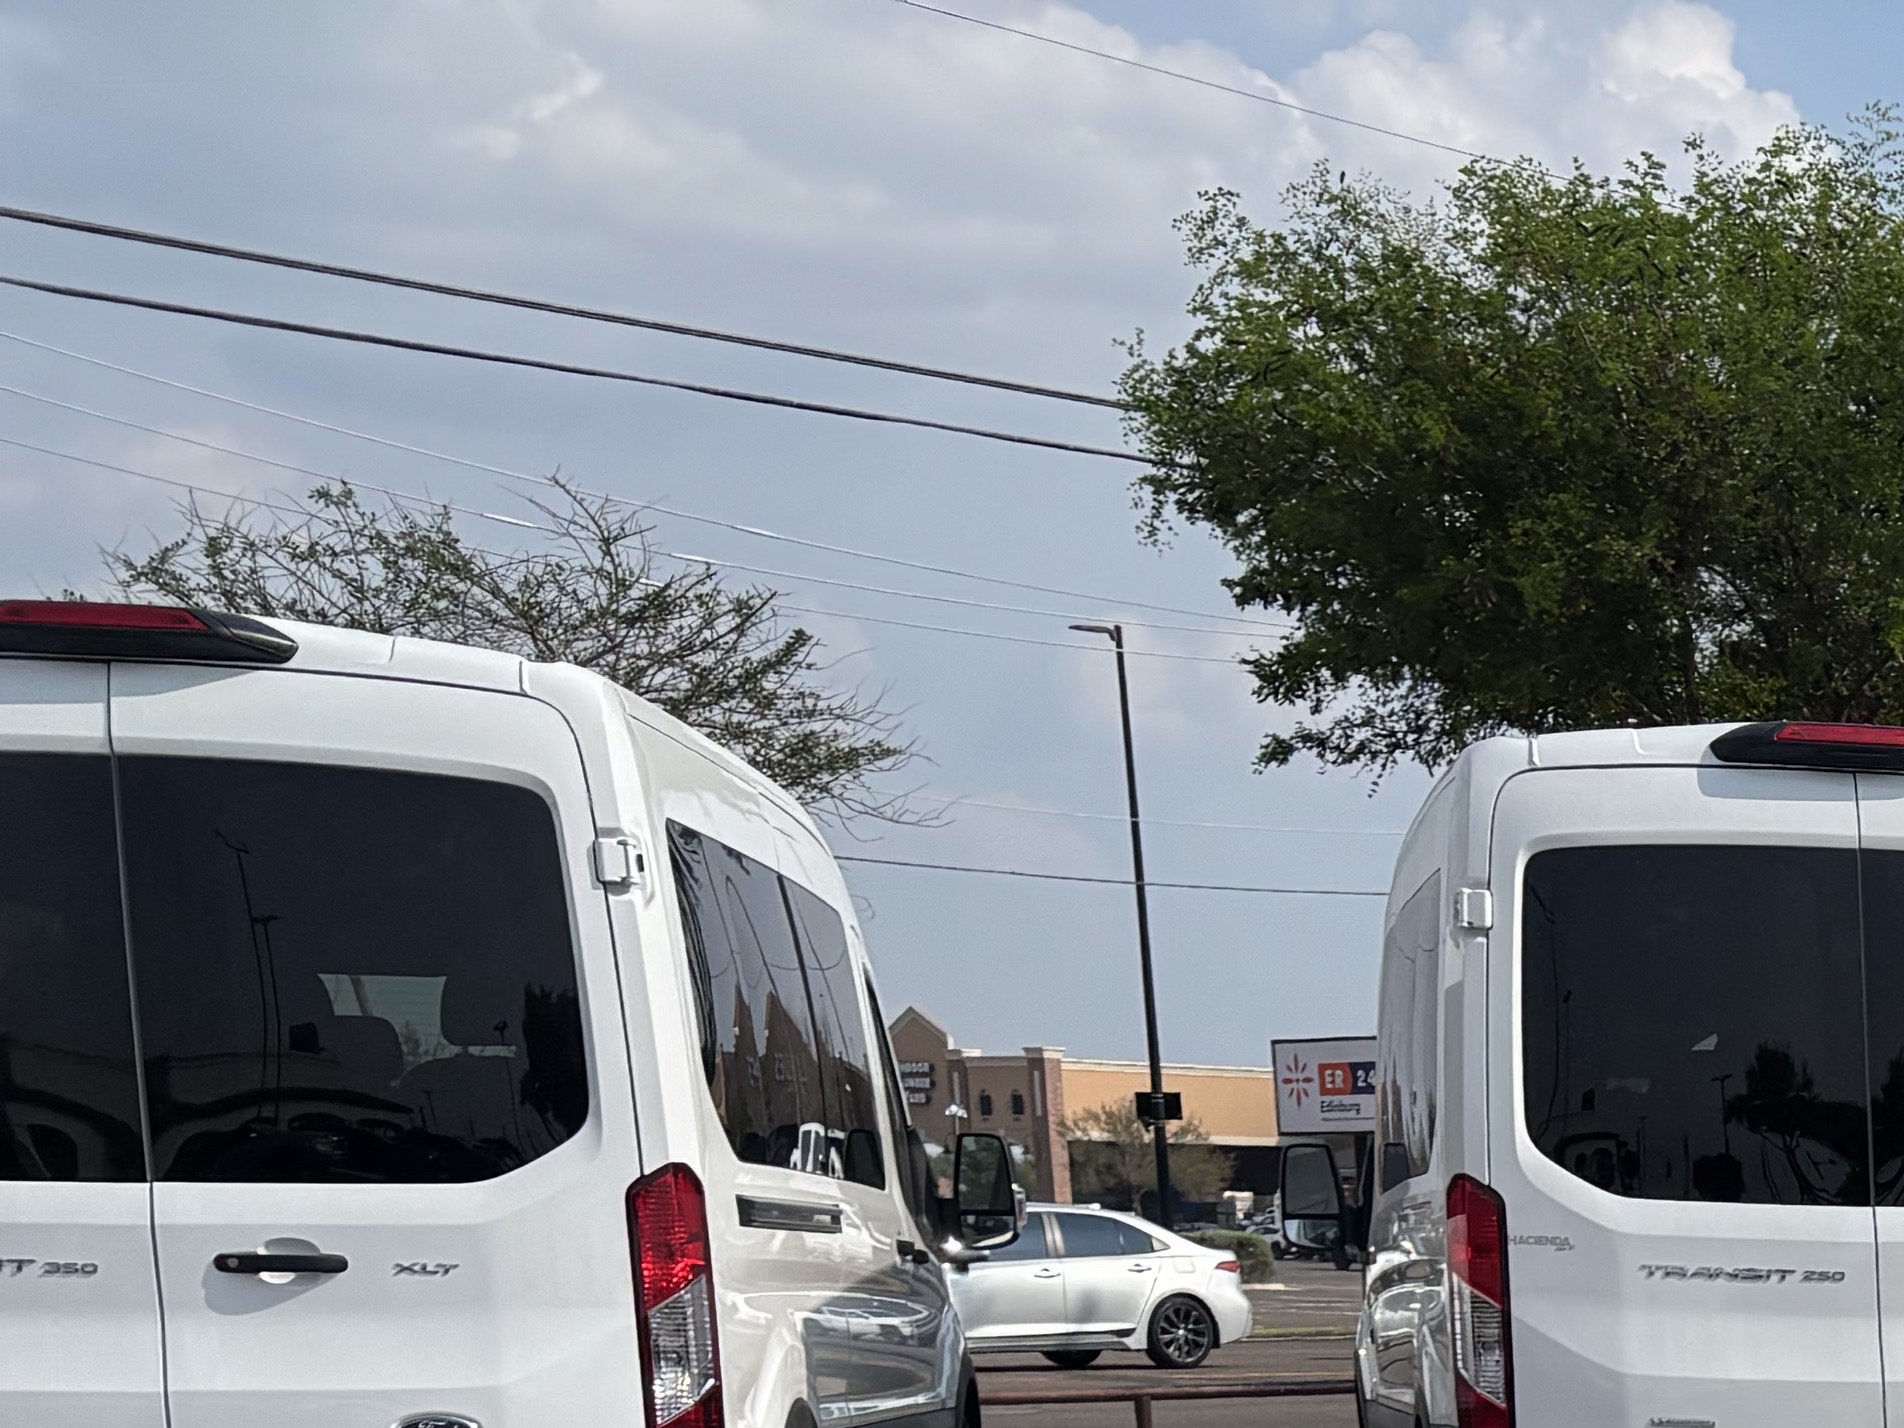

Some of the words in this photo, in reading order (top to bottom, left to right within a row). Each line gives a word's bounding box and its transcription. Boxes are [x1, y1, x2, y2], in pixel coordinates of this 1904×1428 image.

[1324, 1068, 1345, 1089] ER
[391, 1262, 460, 1277] XLT
[1638, 1263, 1796, 1283] TRANSIT
[1799, 1270, 1846, 1283] 250
